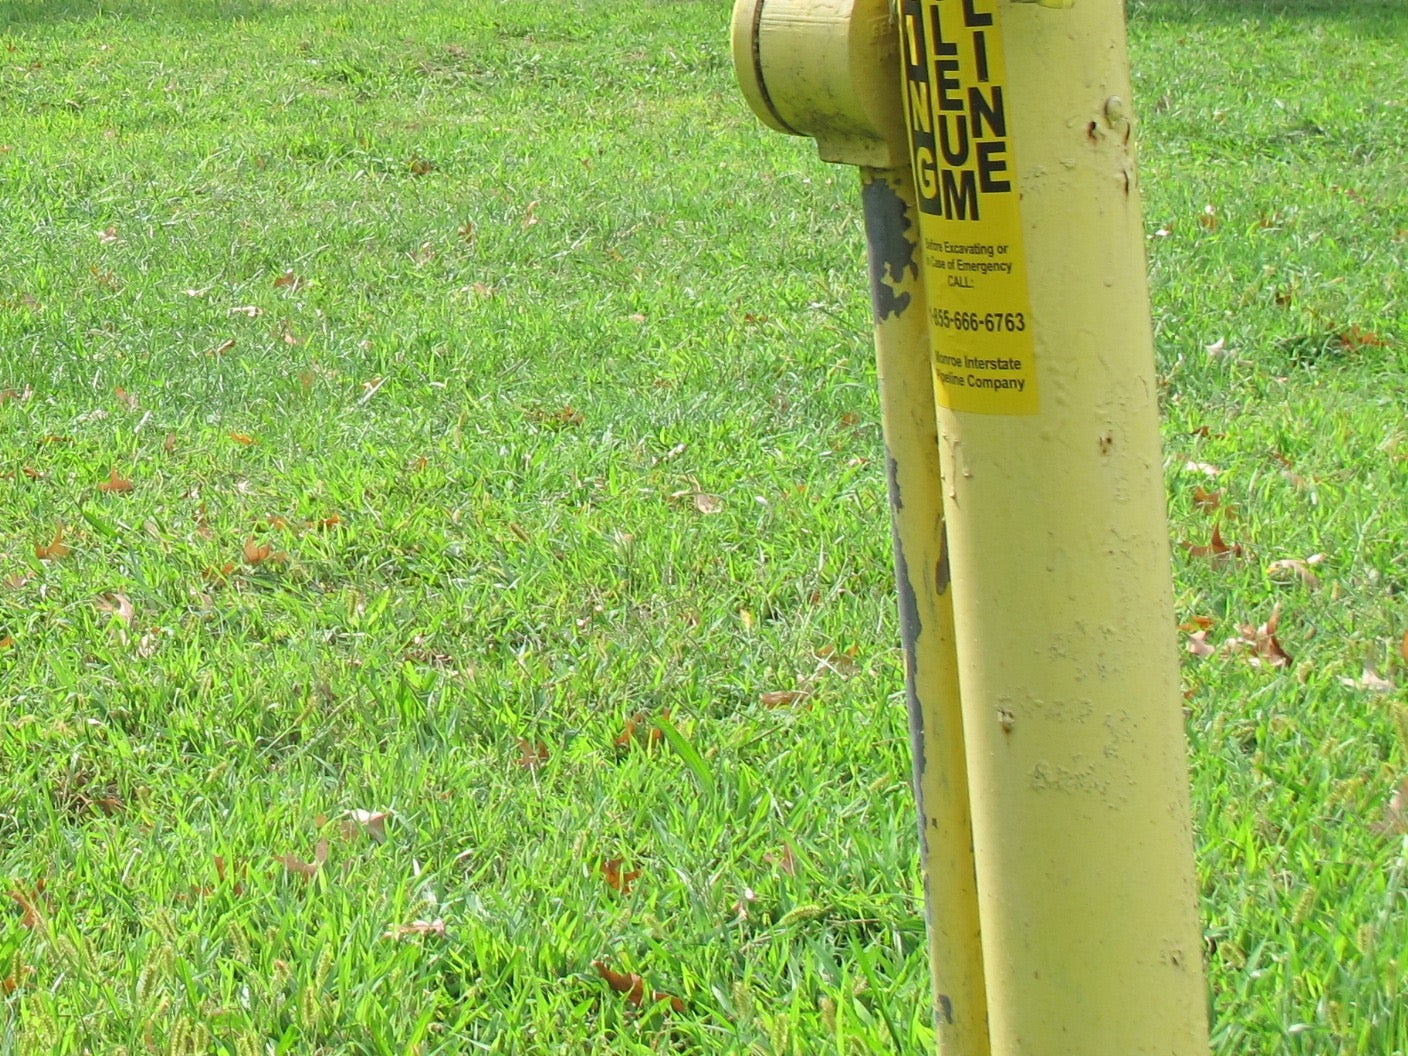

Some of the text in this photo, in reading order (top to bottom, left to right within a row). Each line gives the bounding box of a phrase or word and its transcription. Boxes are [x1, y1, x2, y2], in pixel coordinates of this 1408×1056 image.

[944, 241, 994, 257] Excavating
[997, 245, 1008, 254] or
[948, 259, 955, 270] of
[957, 259, 1012, 274] Emergency
[965, 355, 1021, 370] Interstate
[967, 374, 1025, 392] Company
